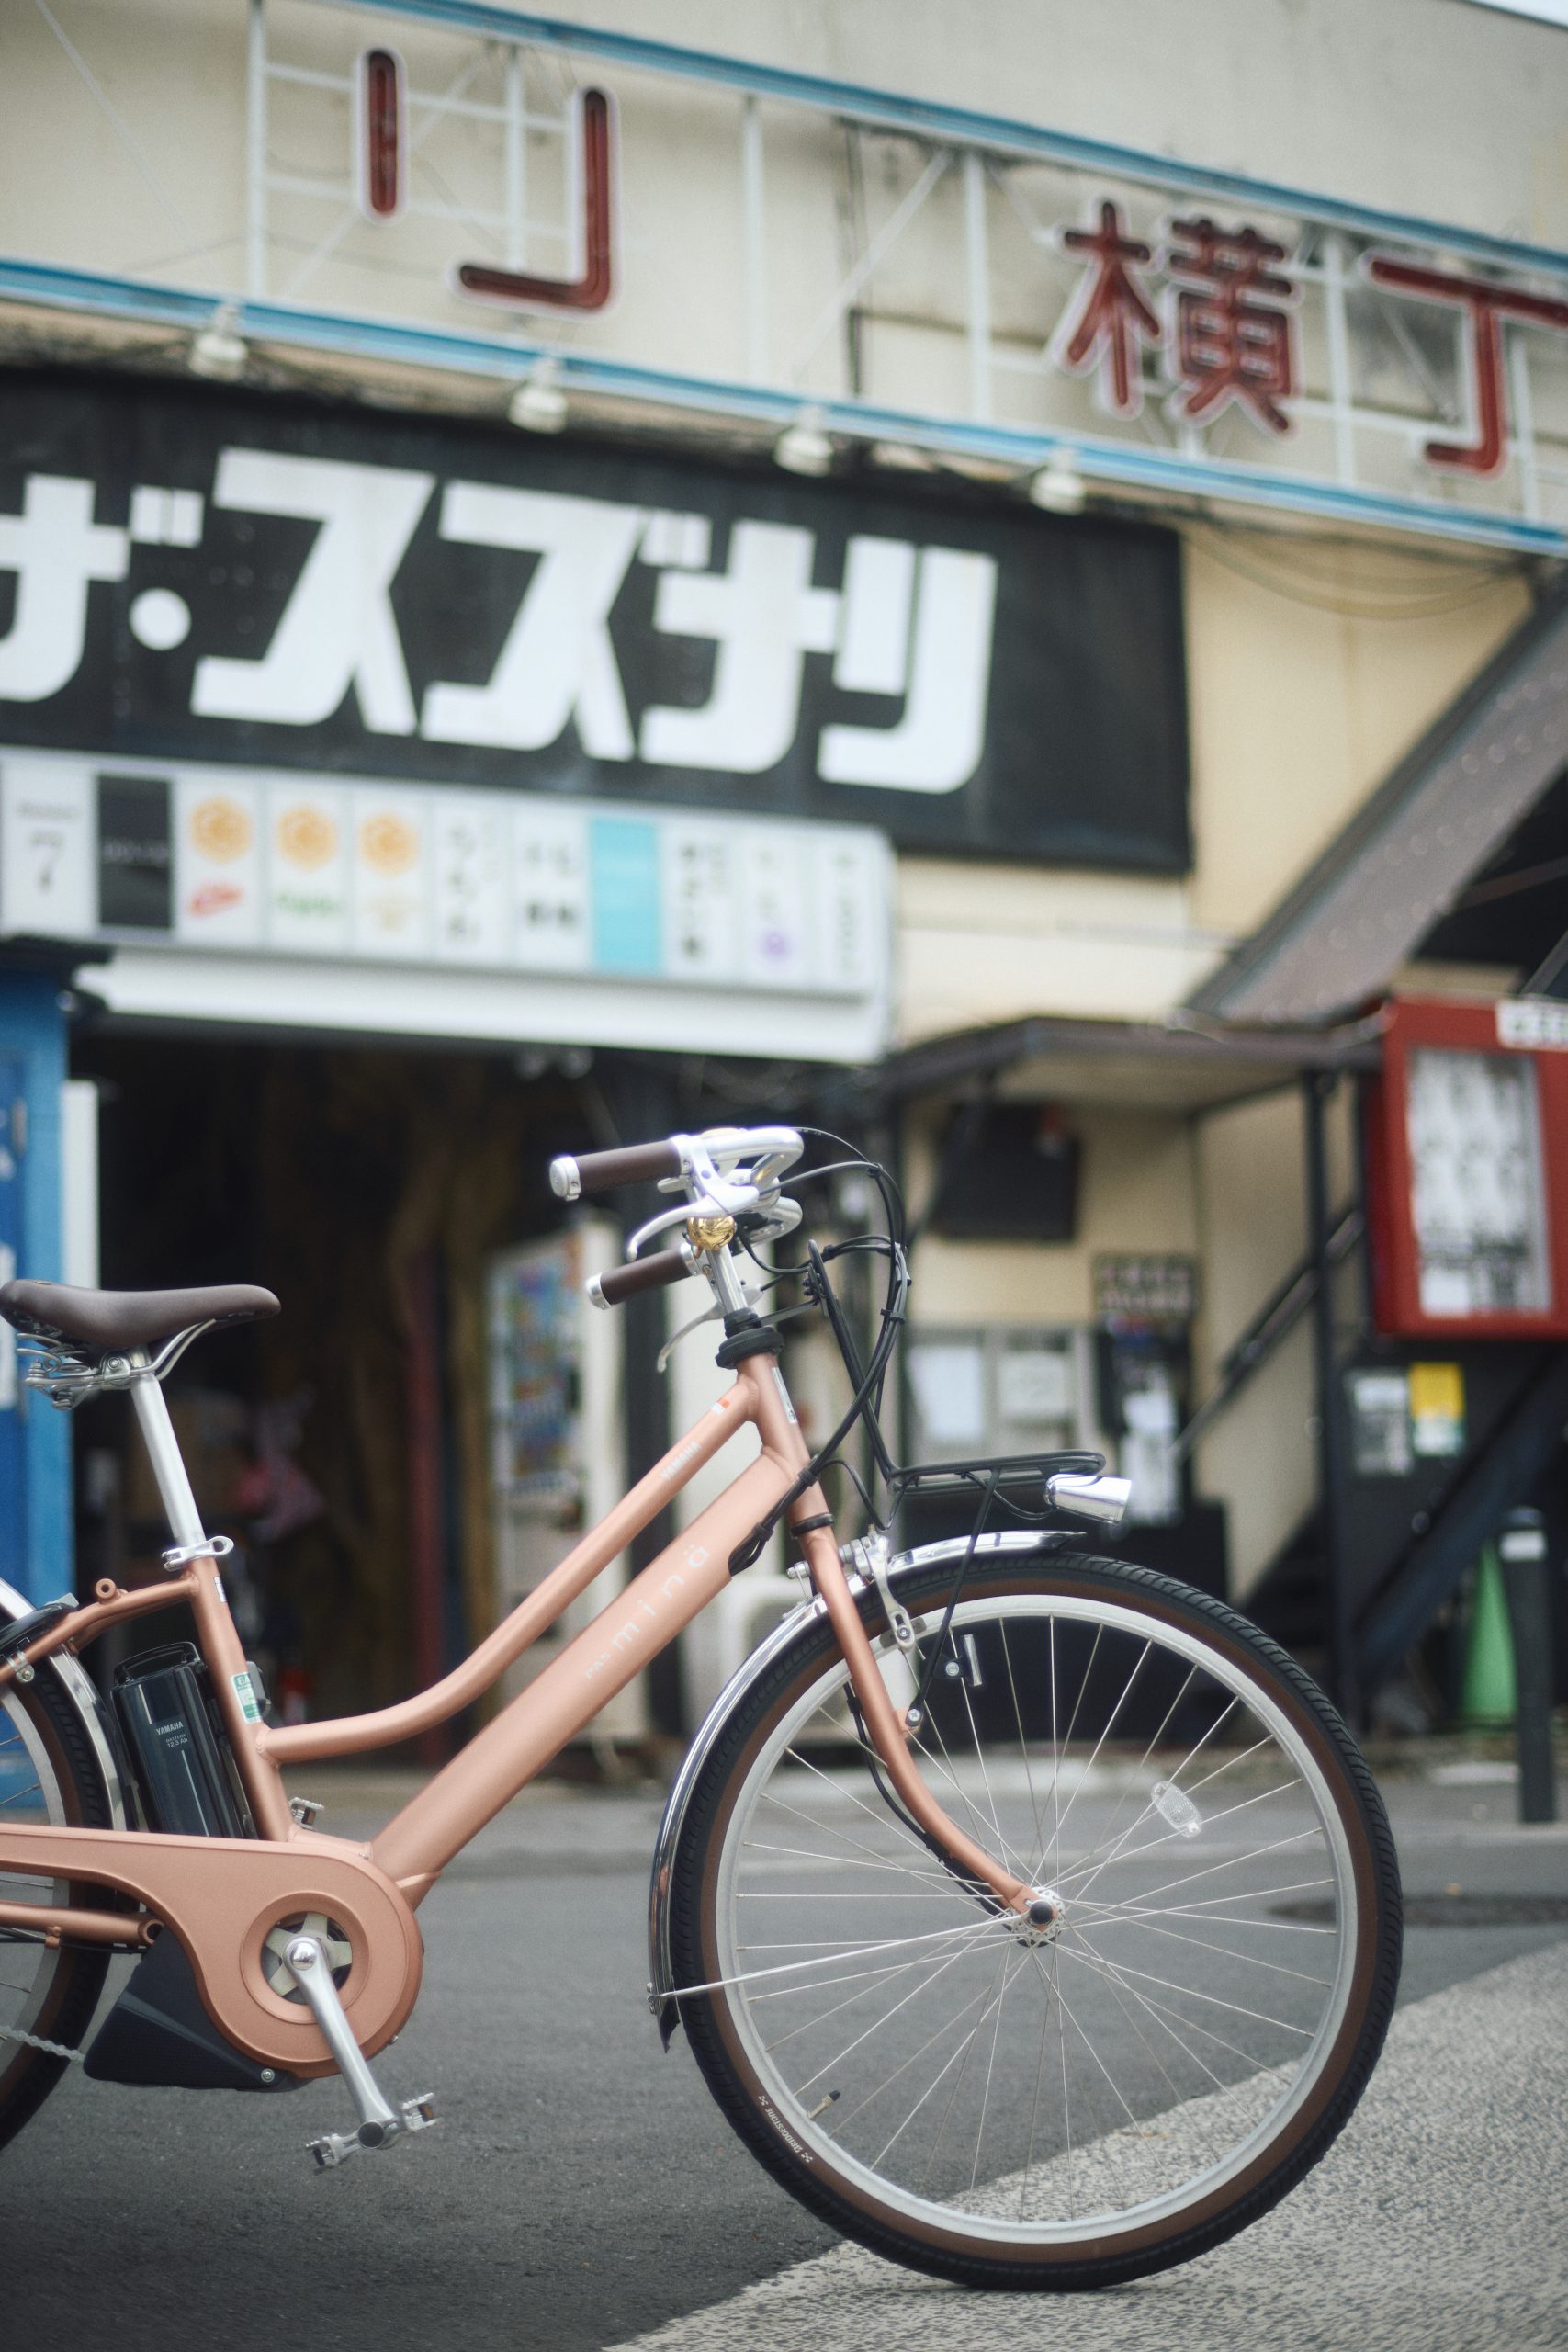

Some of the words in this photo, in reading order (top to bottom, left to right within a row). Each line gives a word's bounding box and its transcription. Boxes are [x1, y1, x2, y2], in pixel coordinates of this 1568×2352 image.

[1062, 200, 1568, 476] 横丁
[156, 1721, 184, 1736] YAMAHA
[167, 1739, 180, 1748] 12.3
[765, 2108, 803, 2153] BRIDGESTONE
